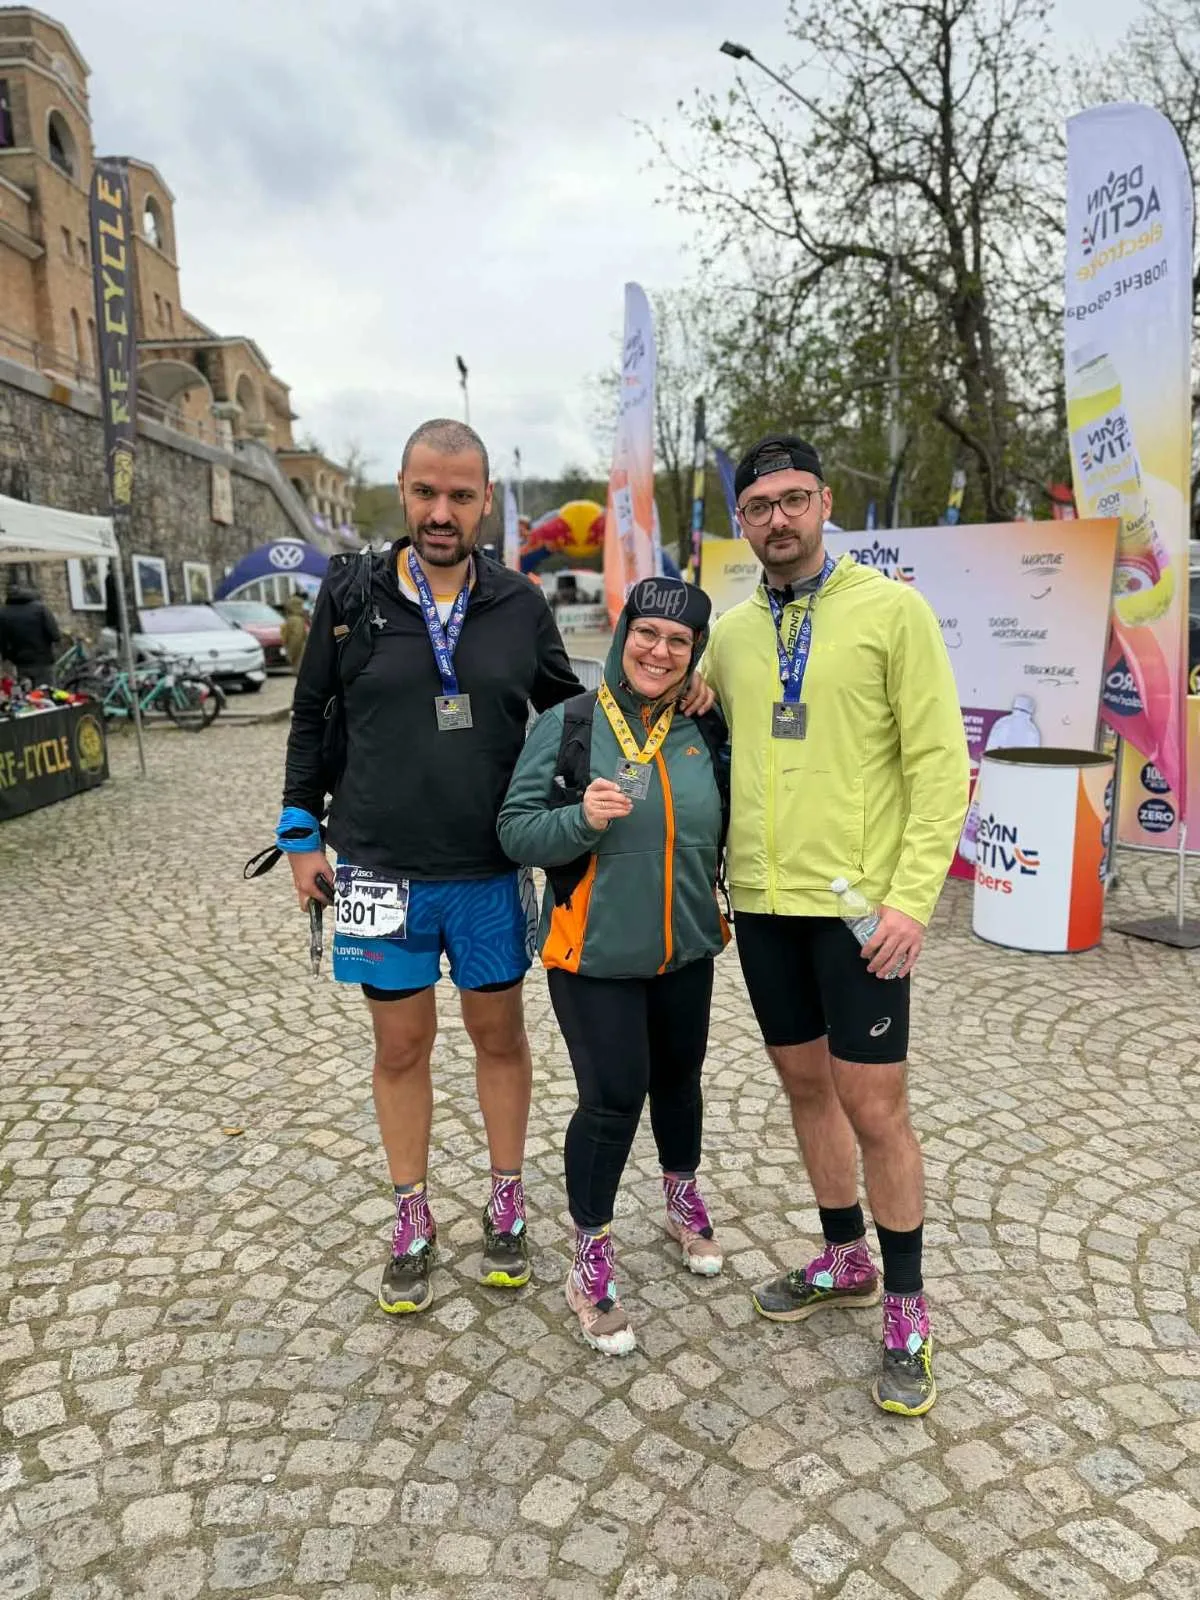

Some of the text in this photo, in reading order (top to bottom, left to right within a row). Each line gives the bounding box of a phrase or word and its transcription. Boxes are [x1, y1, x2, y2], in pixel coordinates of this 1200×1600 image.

[97, 174, 130, 424] RE-CYCLE
[849, 540, 899, 565] DEVIN
[787, 610, 801, 656] UNDER
[978, 814, 1018, 844] EVIN
[1140, 809, 1174, 822] ZERO
